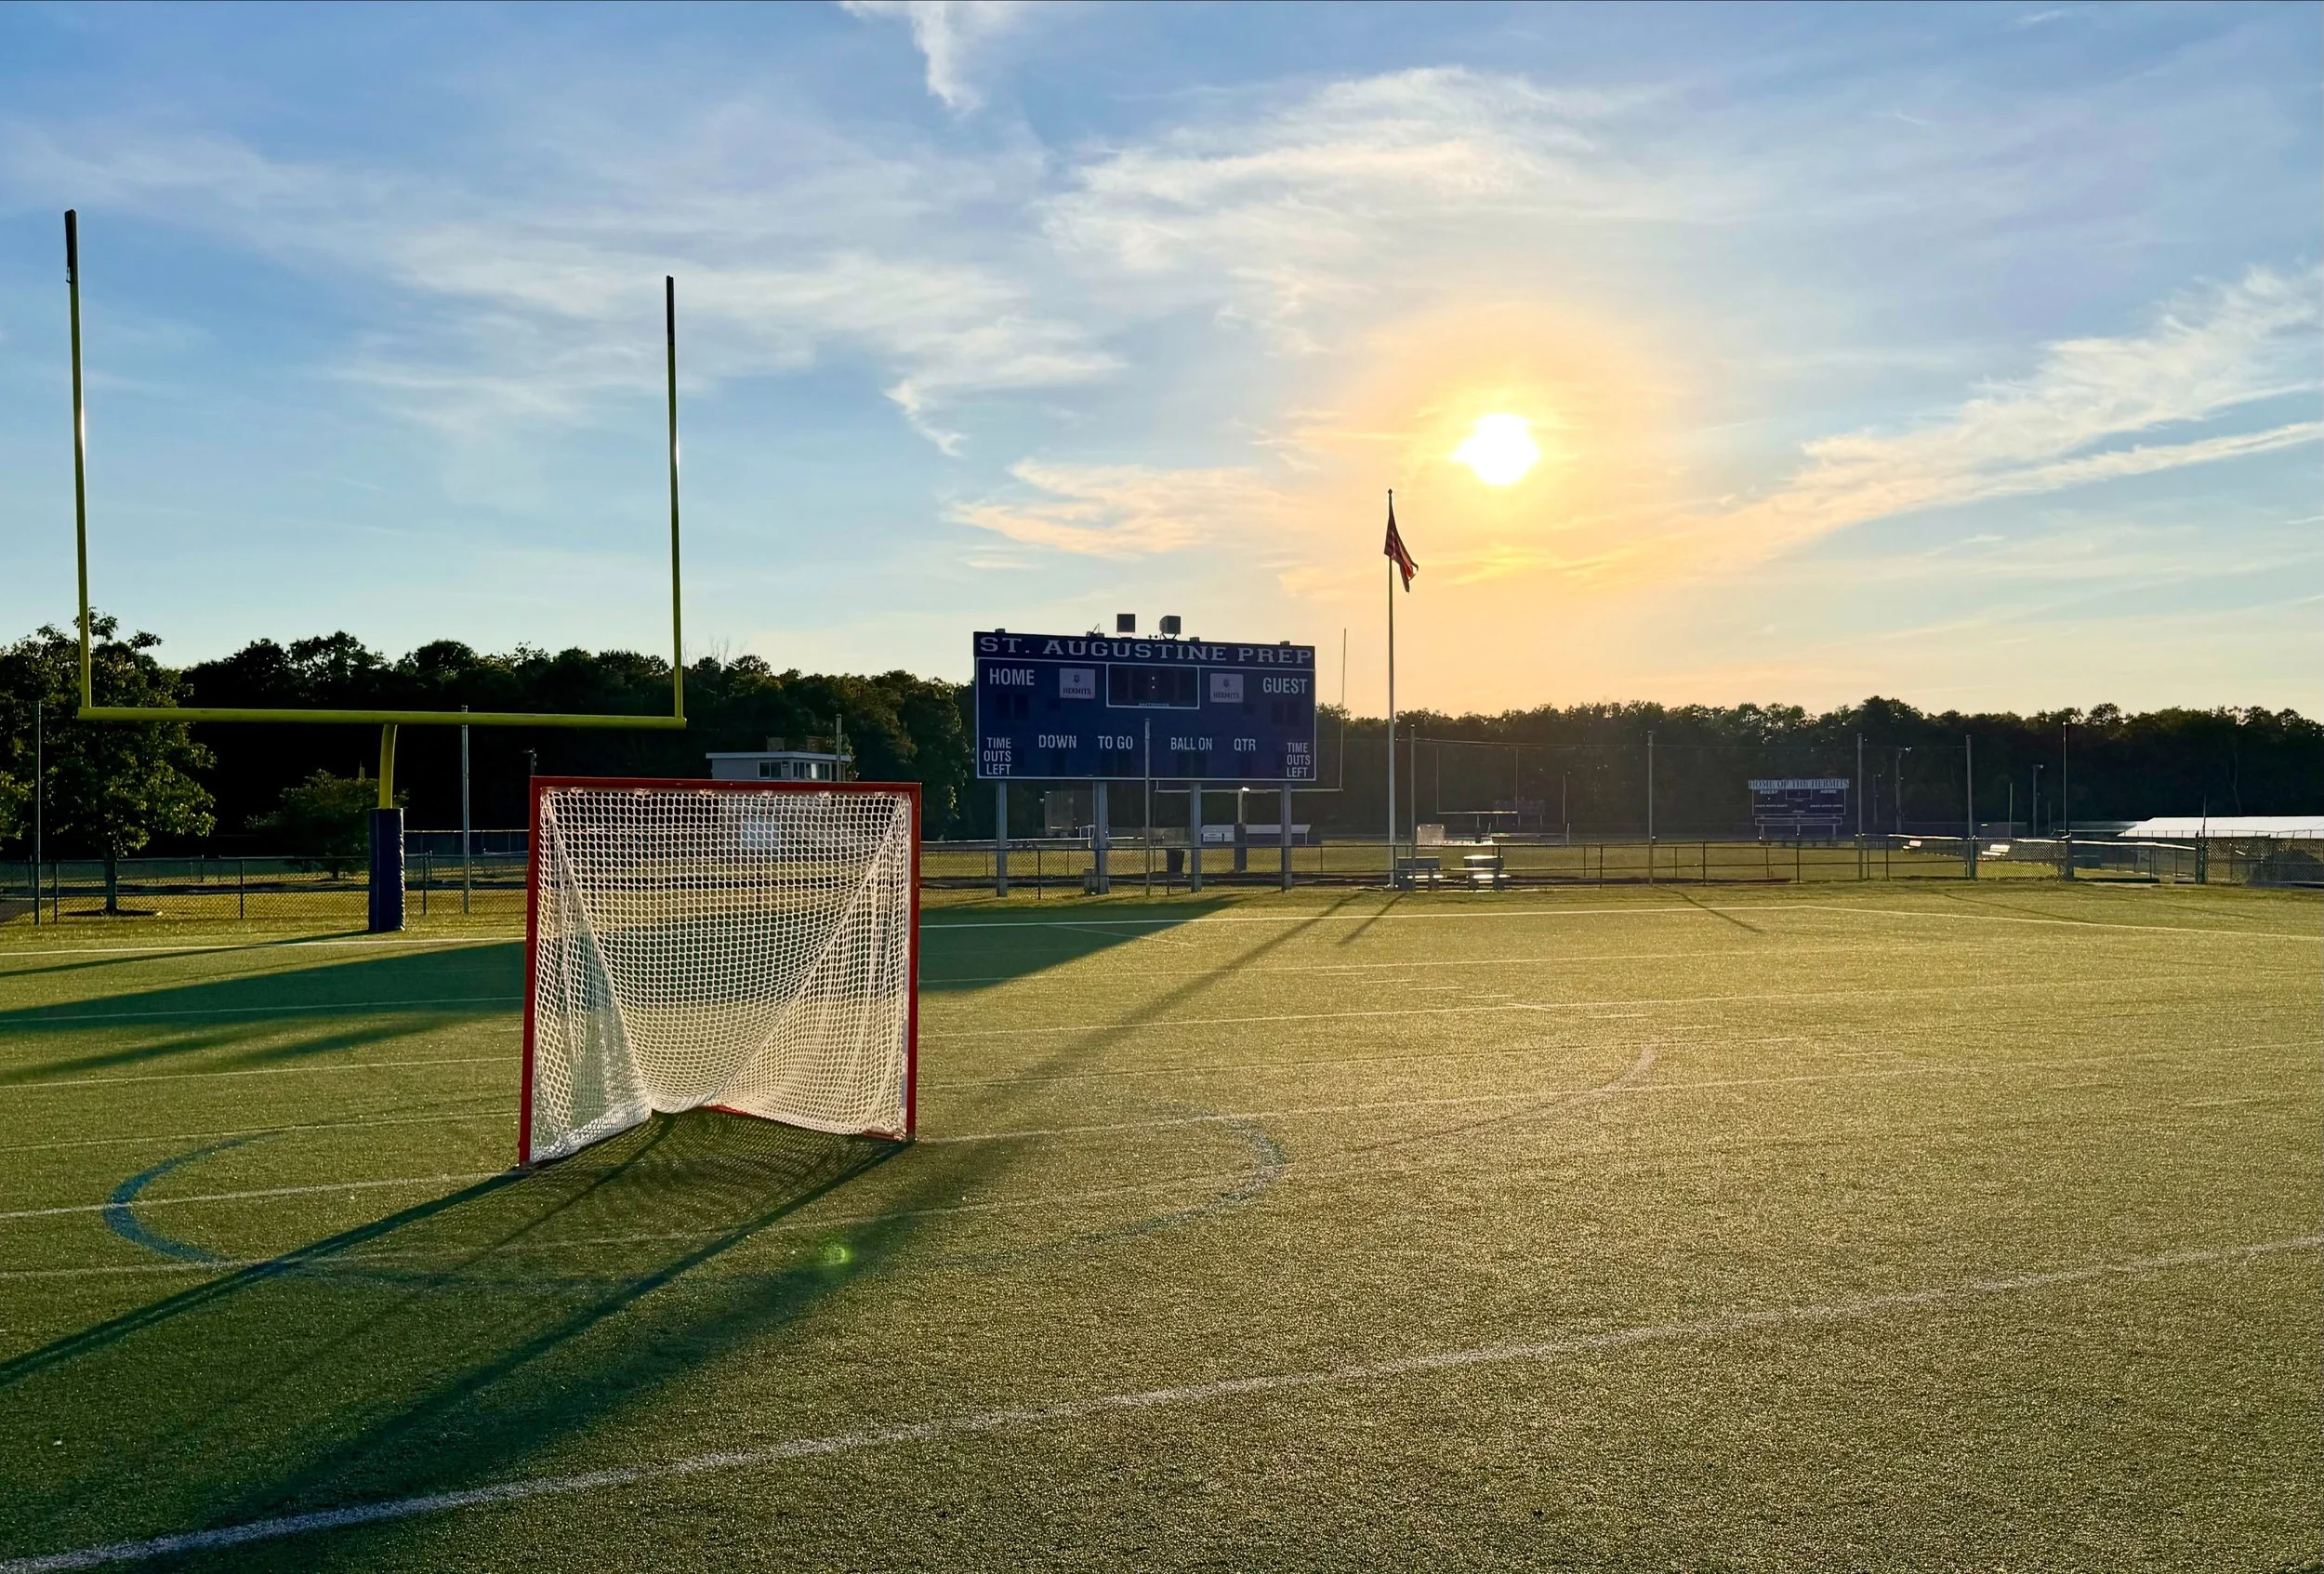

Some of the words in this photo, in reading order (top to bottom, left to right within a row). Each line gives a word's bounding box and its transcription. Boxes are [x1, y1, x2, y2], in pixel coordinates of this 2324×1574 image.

[980, 636, 1030, 654] ST.
[1042, 639, 1226, 661] AUGUSTINE
[1237, 646, 1312, 664] PREP
[989, 668, 1035, 685] HOME
[1262, 677, 1307, 694] GUEST
[986, 737, 1011, 749] TIME
[1038, 734, 1076, 748] DOWN
[1098, 735, 1113, 749] TO
[1116, 735, 1133, 749] GO
[1170, 737, 1196, 750] BALL
[1198, 737, 1213, 751] ON
[1234, 737, 1256, 751] QTR
[1287, 742, 1308, 753] TIME
[984, 750, 1011, 762] OUTS
[1287, 754, 1311, 766] OUTS
[986, 763, 1011, 775] LEFT
[1287, 767, 1308, 778] LEFT
[1749, 779, 1774, 788] HOME
[1791, 779, 1809, 788] THE
